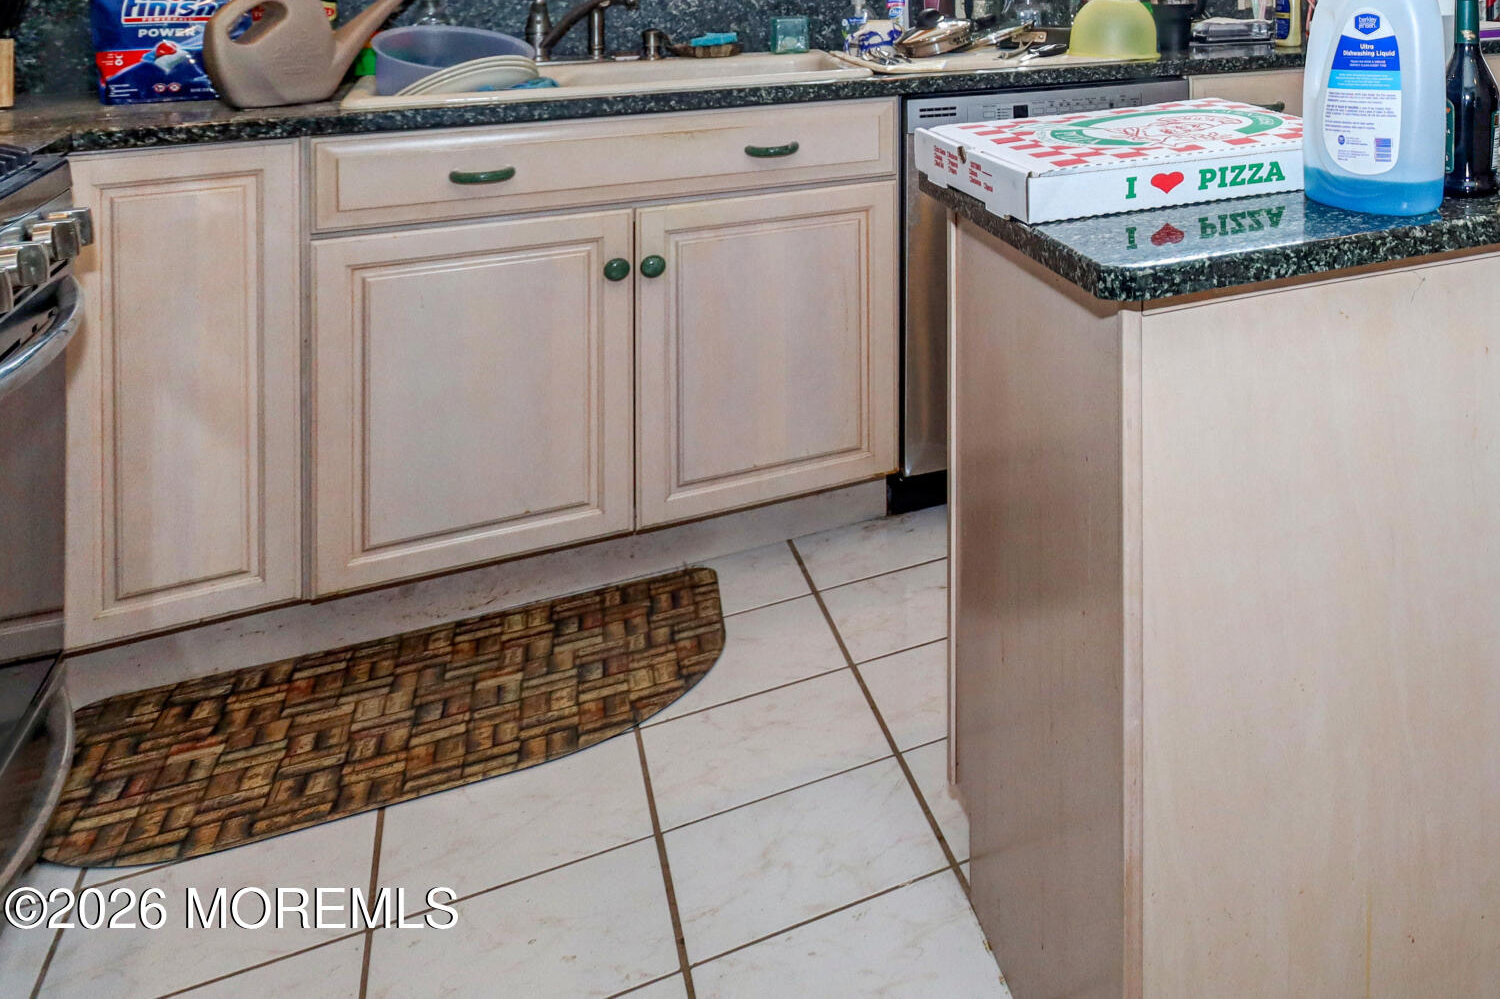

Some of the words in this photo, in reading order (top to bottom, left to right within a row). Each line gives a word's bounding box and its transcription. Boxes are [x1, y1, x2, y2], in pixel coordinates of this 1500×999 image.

[138, 28, 196, 38] POWER
[1125, 176, 1137, 200] I
[1198, 161, 1286, 190] PIZZA
